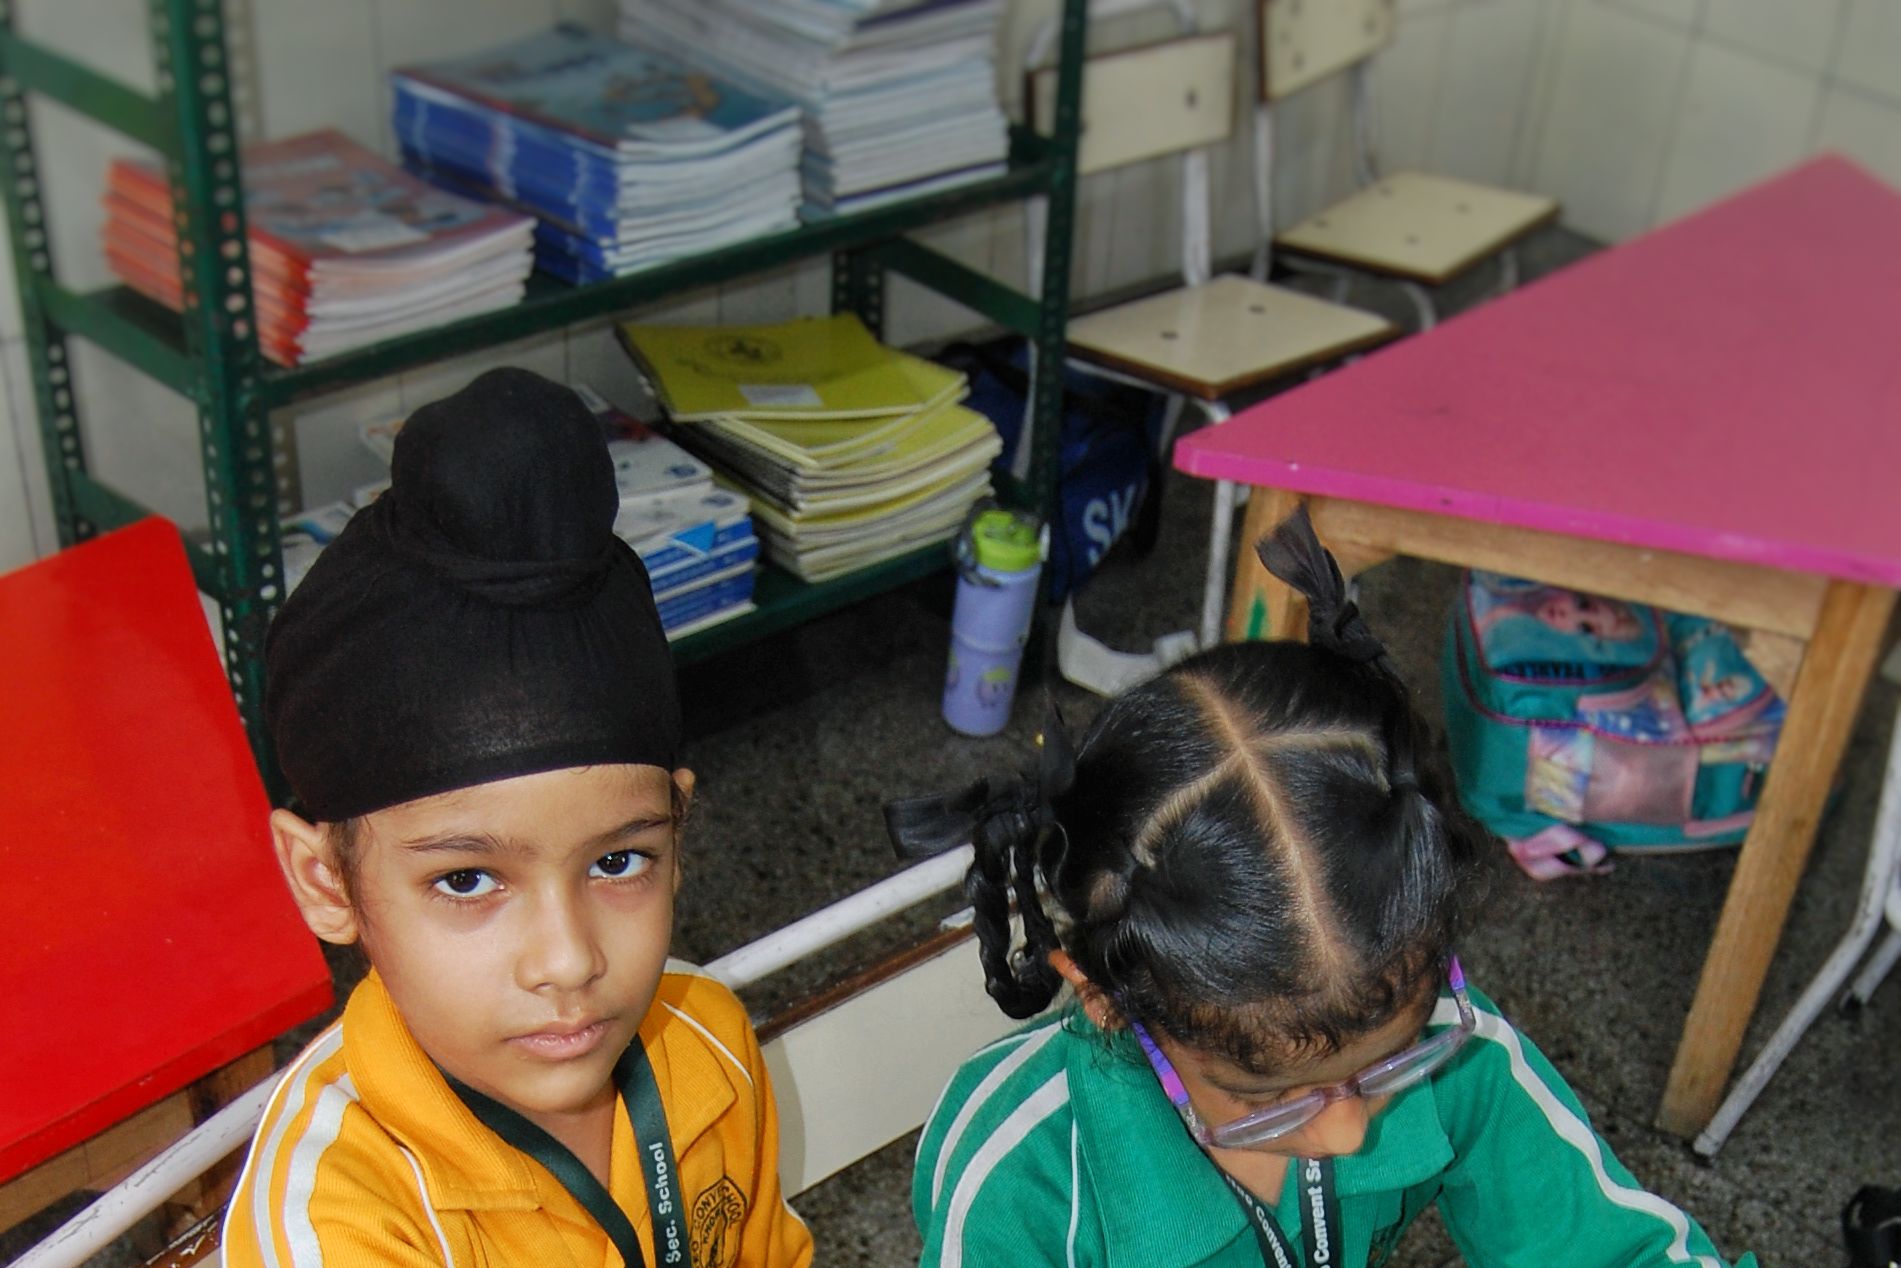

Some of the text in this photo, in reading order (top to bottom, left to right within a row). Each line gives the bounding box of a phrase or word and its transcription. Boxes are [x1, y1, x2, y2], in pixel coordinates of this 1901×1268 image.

[649, 1142, 673, 1215] School
[665, 1219, 682, 1264] Sec.
[1307, 1185, 1330, 1264] Convent
